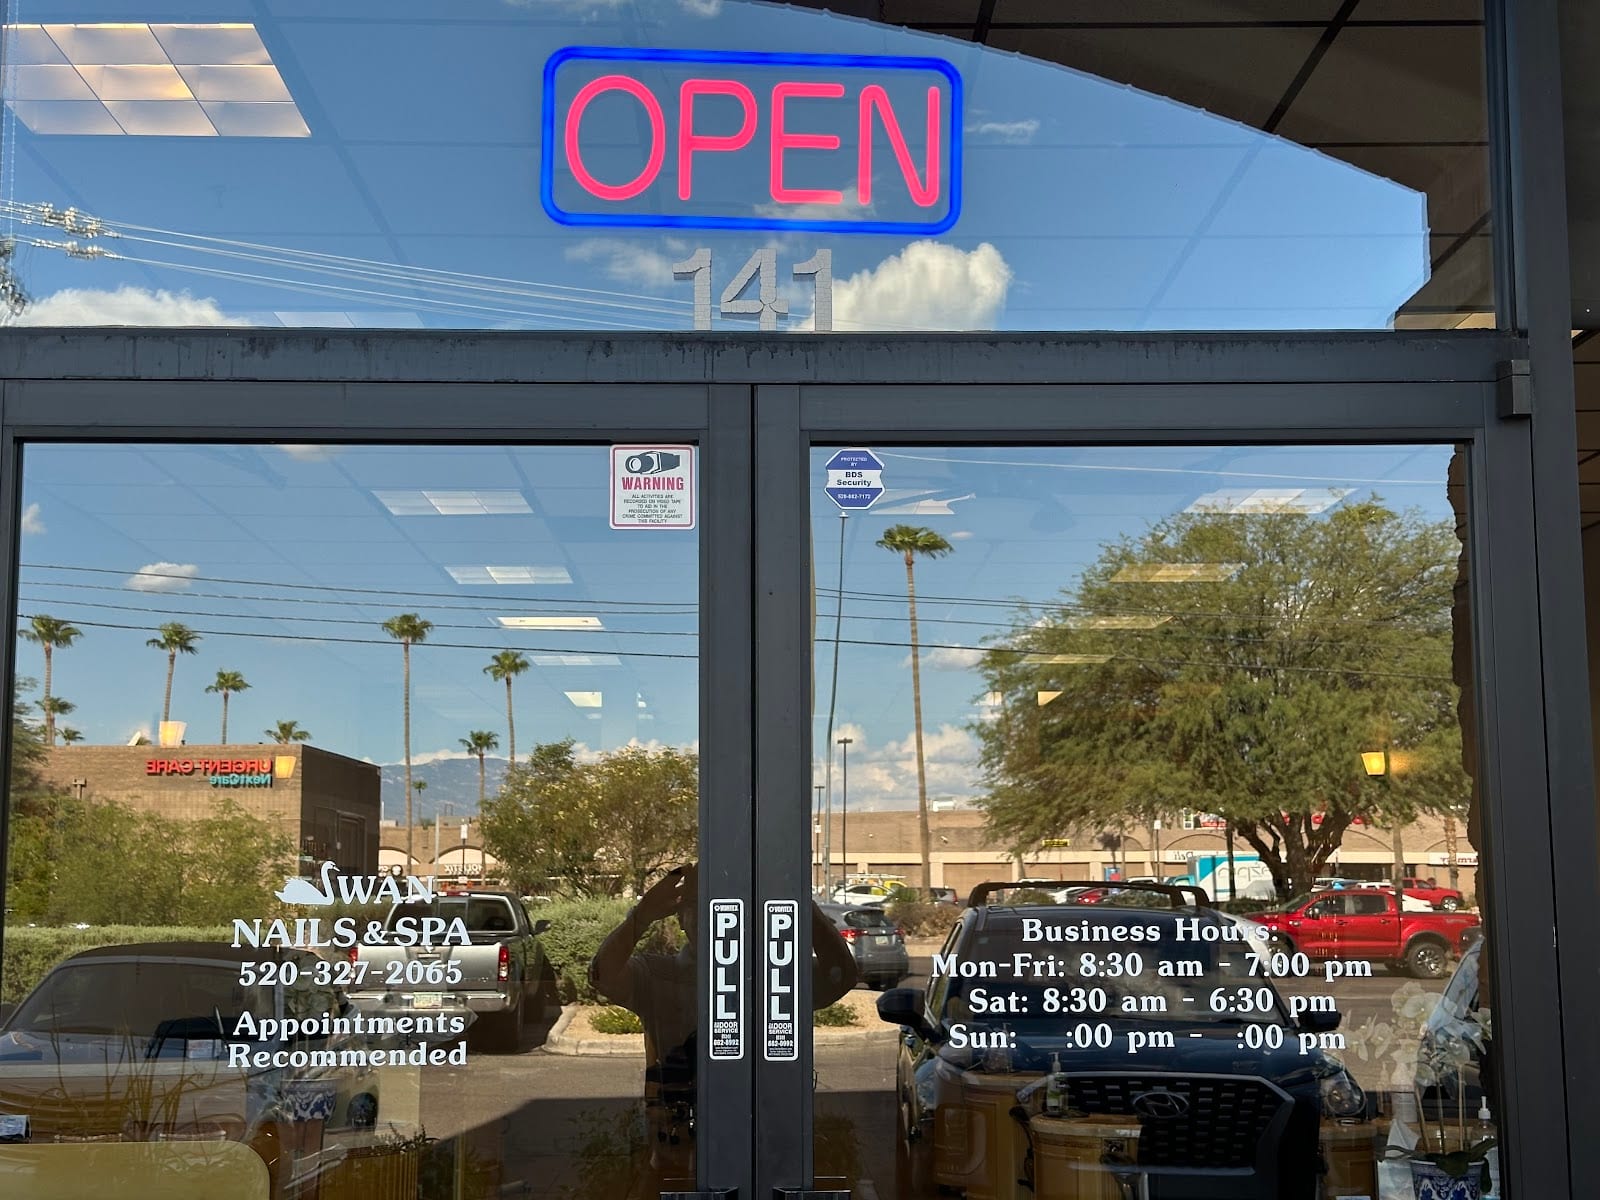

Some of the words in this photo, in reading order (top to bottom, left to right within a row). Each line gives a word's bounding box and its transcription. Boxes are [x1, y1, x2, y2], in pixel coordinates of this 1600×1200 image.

[564, 74, 941, 207] OPEN
[672, 248, 832, 331] 141
[622, 476, 684, 490] WARNING
[836, 479, 872, 487] Security
[230, 918, 357, 948] NAILS
[363, 920, 389, 945] &
[394, 916, 472, 946] SPA
[1022, 918, 1161, 942] Business
[1176, 918, 1280, 942] Hours:
[238, 959, 462, 986] 520-327-2065
[715, 913, 739, 1019] PULL
[769, 914, 793, 1020] PULL
[931, 953, 1065, 978] Mon-Fri:
[1079, 952, 1144, 977] 8:30
[1157, 957, 1204, 977] am
[1244, 952, 1310, 977] 7:00
[1325, 957, 1373, 983] pm
[968, 987, 1029, 1013] Sat:
[1042, 987, 1107, 1013] 8:30
[1121, 994, 1167, 1013] am
[1209, 987, 1274, 1013] 6:30
[1289, 993, 1337, 1018] pm
[232, 1011, 465, 1042] Appointments
[948, 1024, 1017, 1049] Sun:
[1066, 1024, 1113, 1049] :00
[1127, 1030, 1175, 1054] pm
[1237, 1024, 1283, 1050] :00
[1298, 1030, 1346, 1055] pm
[227, 1041, 468, 1068] Recommended
